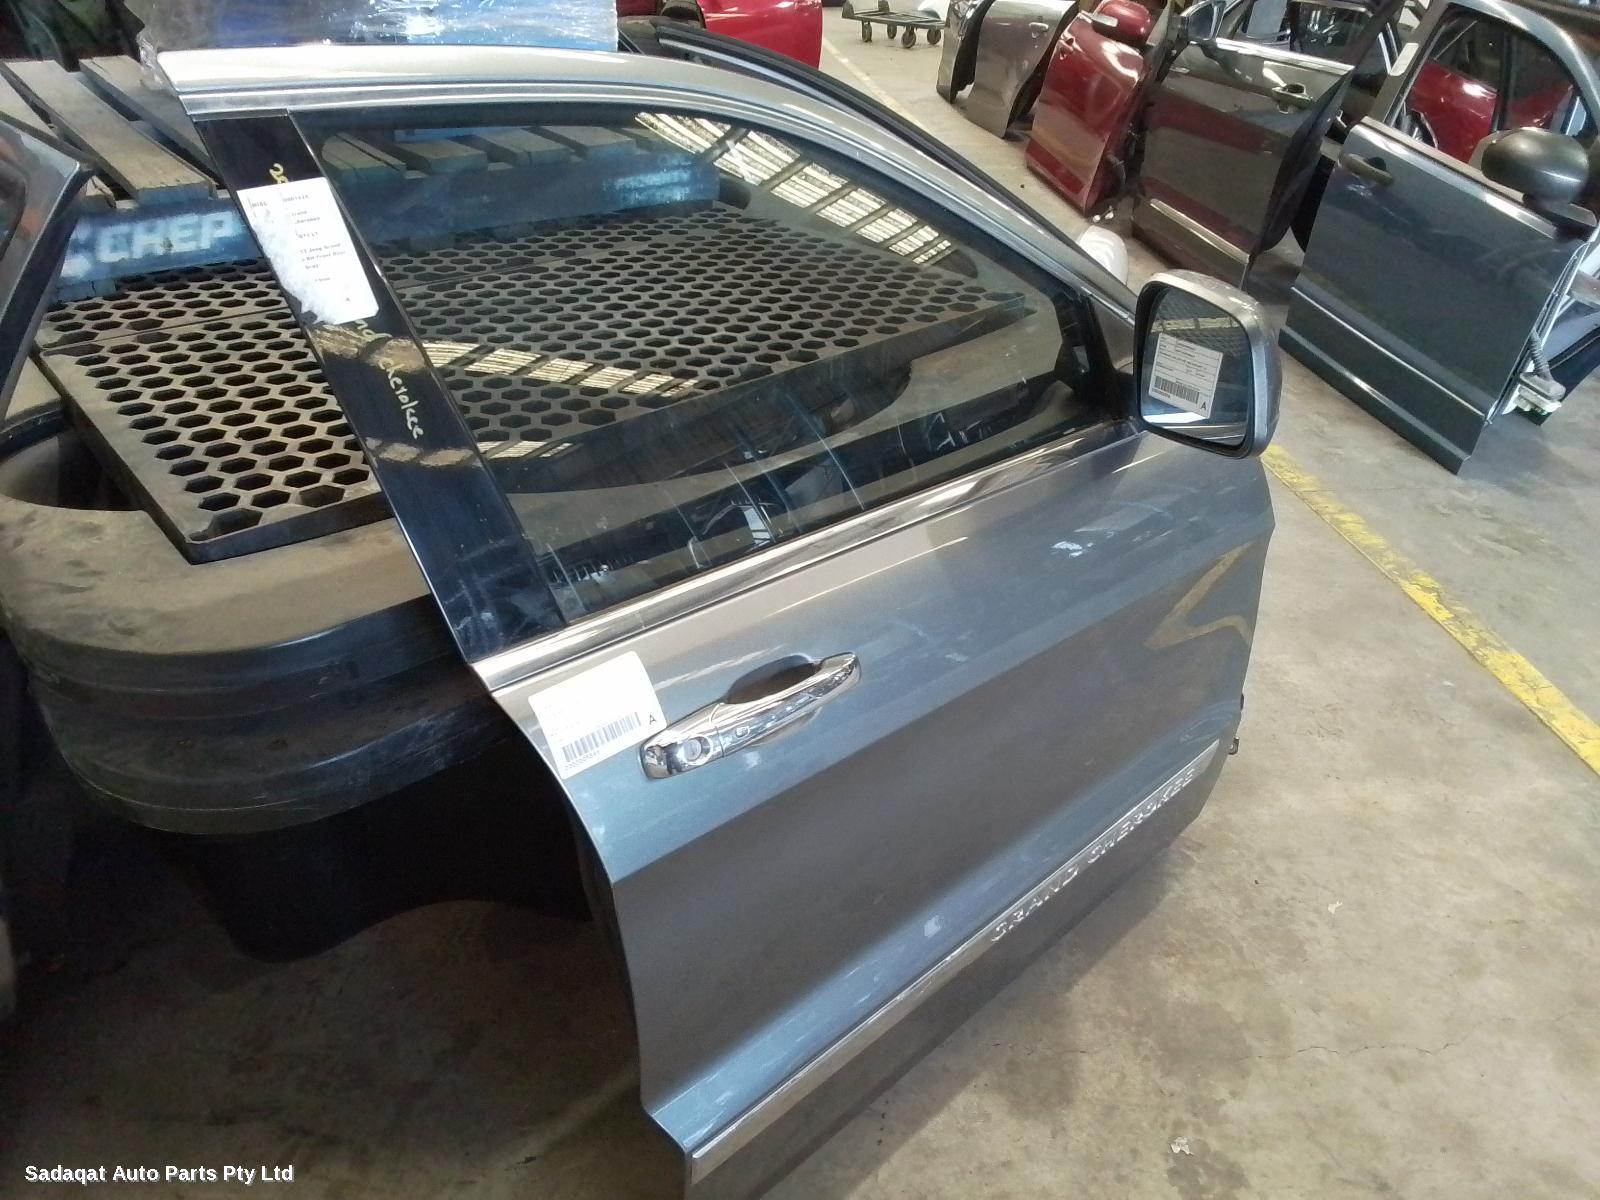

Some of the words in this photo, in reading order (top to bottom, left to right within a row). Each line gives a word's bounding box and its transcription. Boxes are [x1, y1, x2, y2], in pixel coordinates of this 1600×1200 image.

[96, 211, 236, 264] CHEP
[1200, 401, 1207, 411] A
[649, 713, 657, 726] A
[990, 865, 1080, 942] GRAND
[1086, 767, 1196, 865] CHEROKEE
